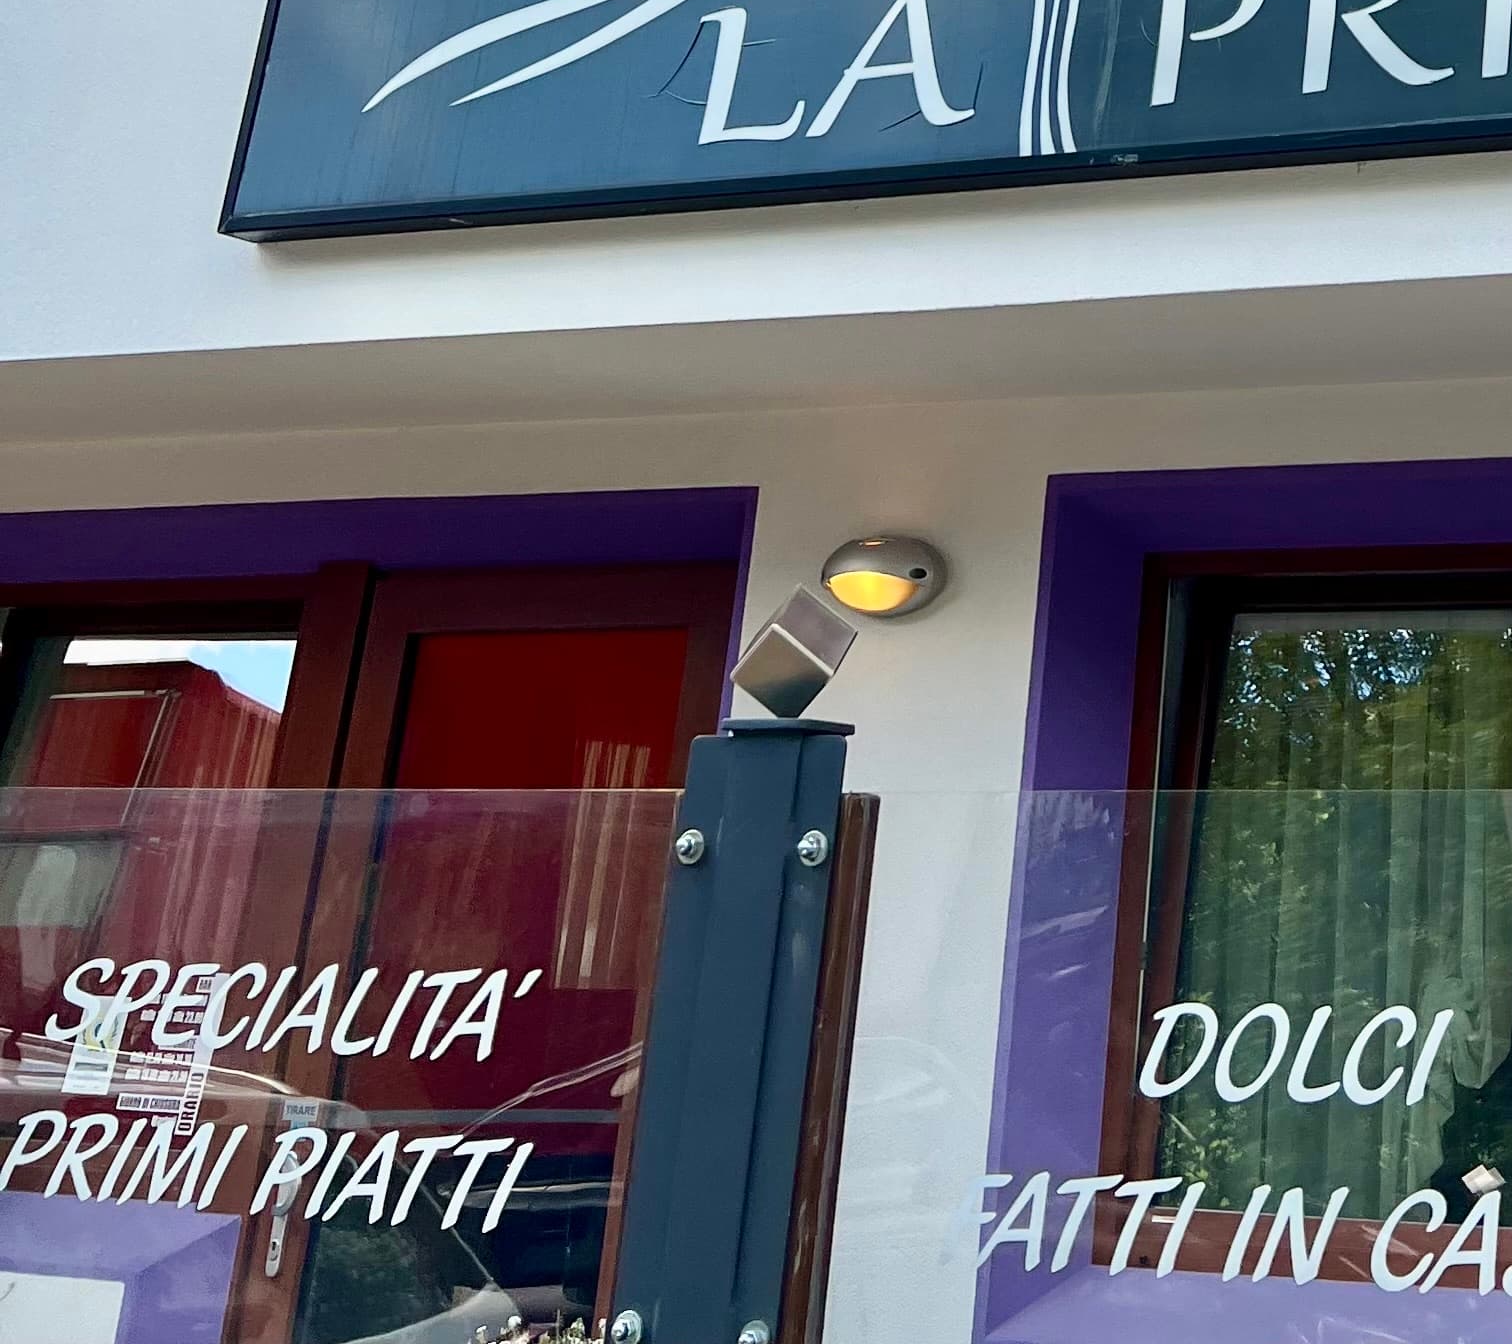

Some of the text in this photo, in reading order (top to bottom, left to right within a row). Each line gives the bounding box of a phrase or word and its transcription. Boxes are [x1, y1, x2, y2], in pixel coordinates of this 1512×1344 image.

[178, 1072, 204, 1131] ORARIO
[1138, 1002, 1455, 1106] DOLCI
[0, 1110, 534, 1234] PRIMI PIATTI
[940, 1171, 1206, 1279] FATTI
[1222, 1184, 1349, 1285] IN
